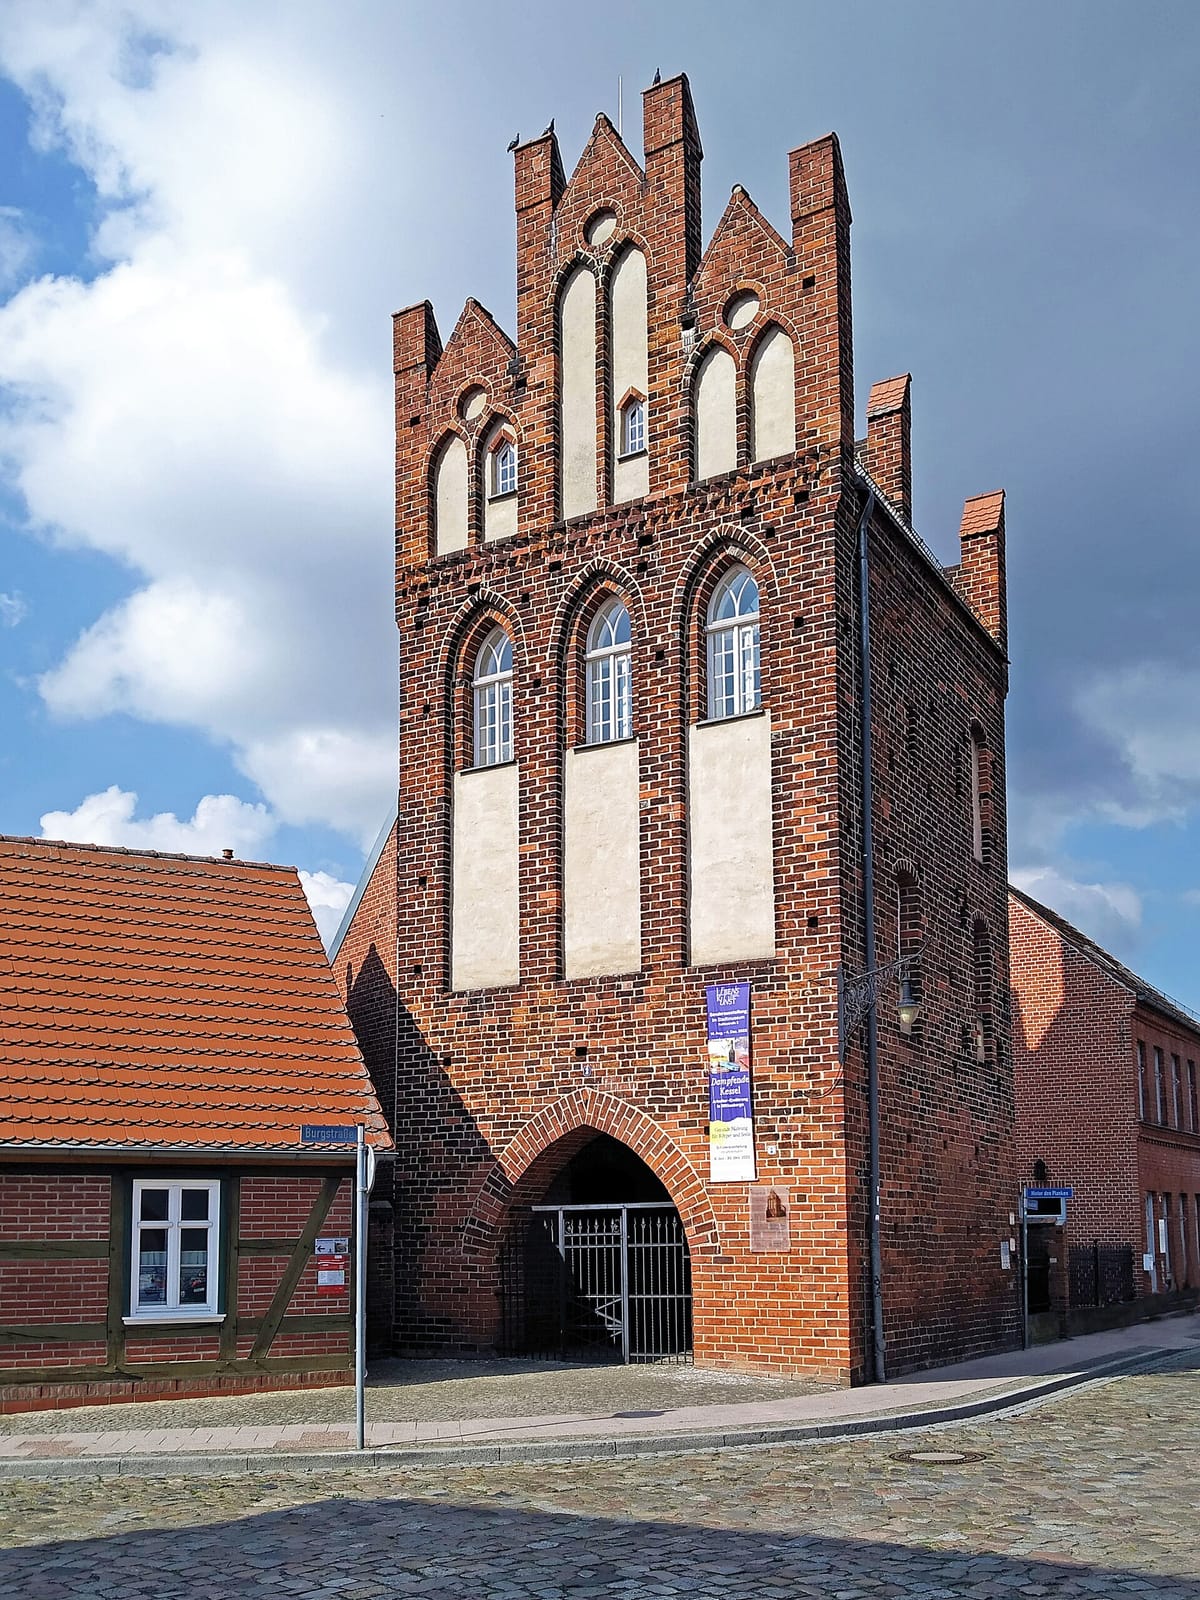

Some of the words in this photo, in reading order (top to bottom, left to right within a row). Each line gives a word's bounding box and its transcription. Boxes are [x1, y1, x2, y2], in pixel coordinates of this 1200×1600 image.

[711, 1075, 750, 1087] Dampfende
[719, 1086, 741, 1096] Kessel
[305, 1127, 354, 1141] Burgstraße
